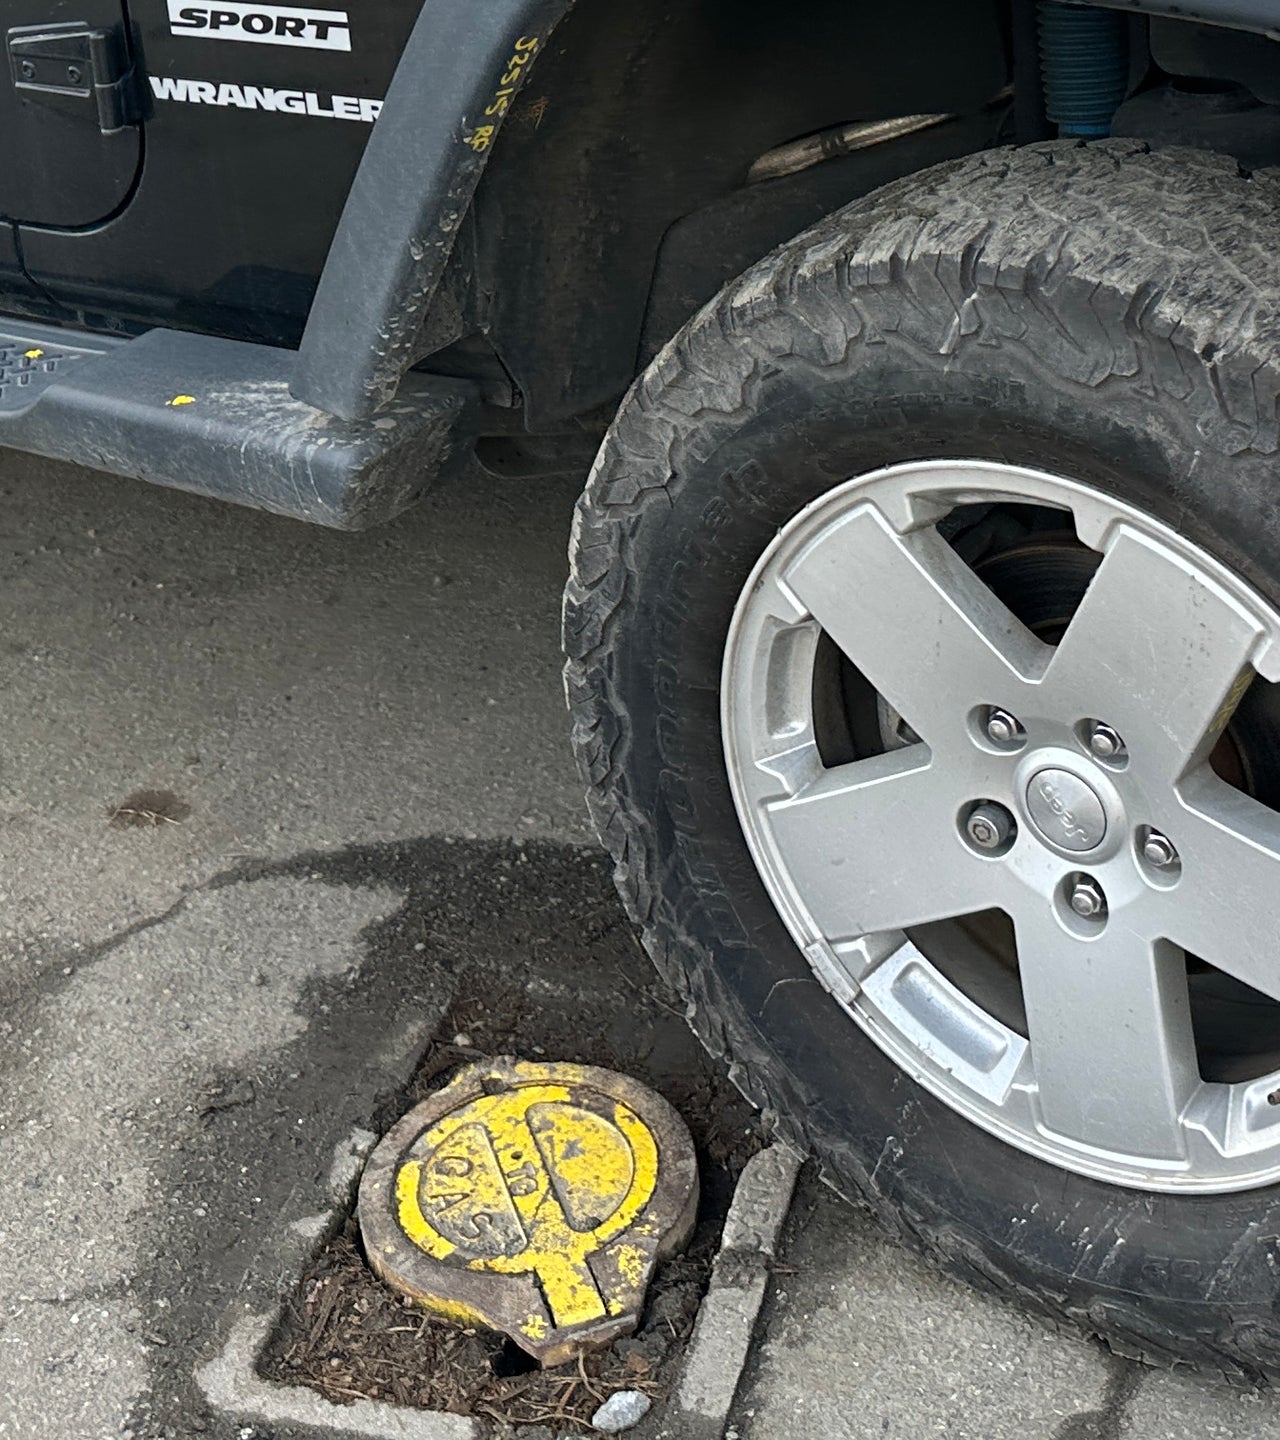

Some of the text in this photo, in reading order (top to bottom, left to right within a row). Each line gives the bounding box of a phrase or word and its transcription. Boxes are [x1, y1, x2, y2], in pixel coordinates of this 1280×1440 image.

[177, 6, 348, 42] SPORT
[149, 75, 385, 123] WRANGLER
[429, 1156, 494, 1240] GAS
